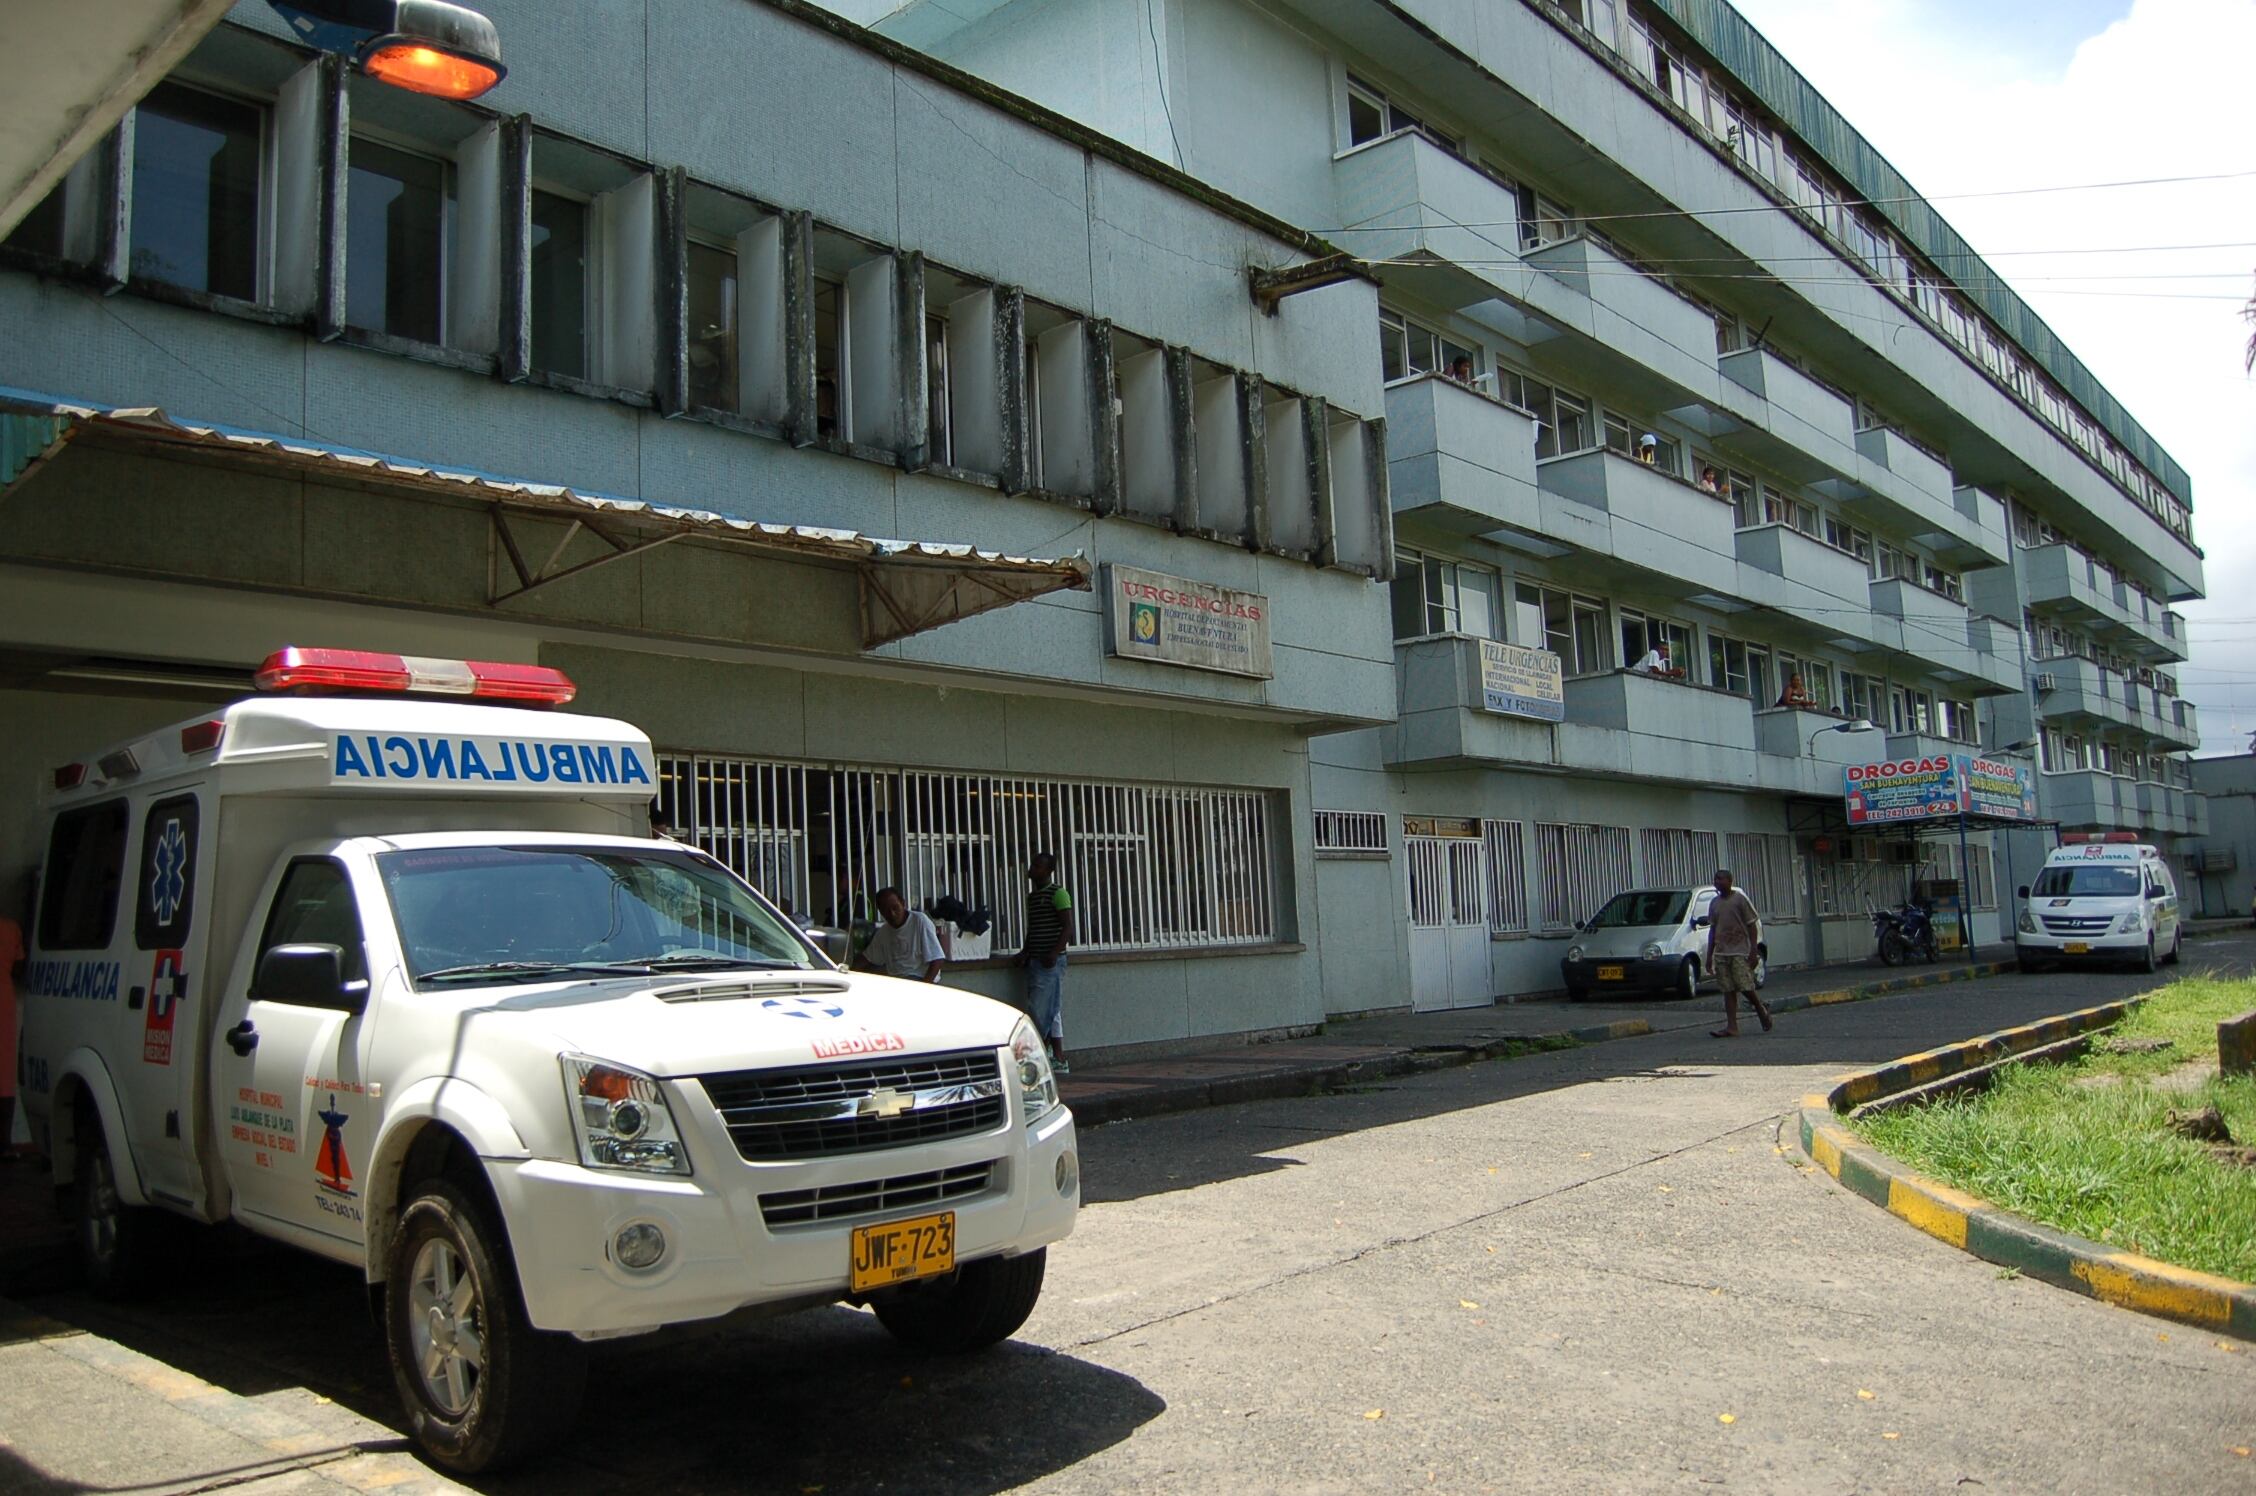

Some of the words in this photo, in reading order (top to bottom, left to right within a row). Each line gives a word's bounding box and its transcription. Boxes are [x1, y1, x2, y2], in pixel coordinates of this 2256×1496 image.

[1122, 581, 1261, 621] URGENCIAS
[1164, 608, 1195, 621] HOSPITAL
[1484, 644, 1506, 663] TELE
[1508, 649, 1559, 674] URGENCIAS
[1493, 663, 1517, 675] SERVICIO
[1485, 670, 1531, 687] INTERNACIONAL
[1485, 680, 1515, 693] NACIONAL
[1536, 681, 1553, 692] LOCAL
[1505, 697, 1512, 709] Y
[1848, 756, 1950, 781] DROGAS
[1972, 760, 2016, 779] DROGAS
[1860, 779, 1877, 791] SAN
[1877, 773, 1940, 788] BUENAVENTURA
[25, 961, 121, 1001] AMBULANCIA
[813, 1032, 906, 1058] MEDICA
